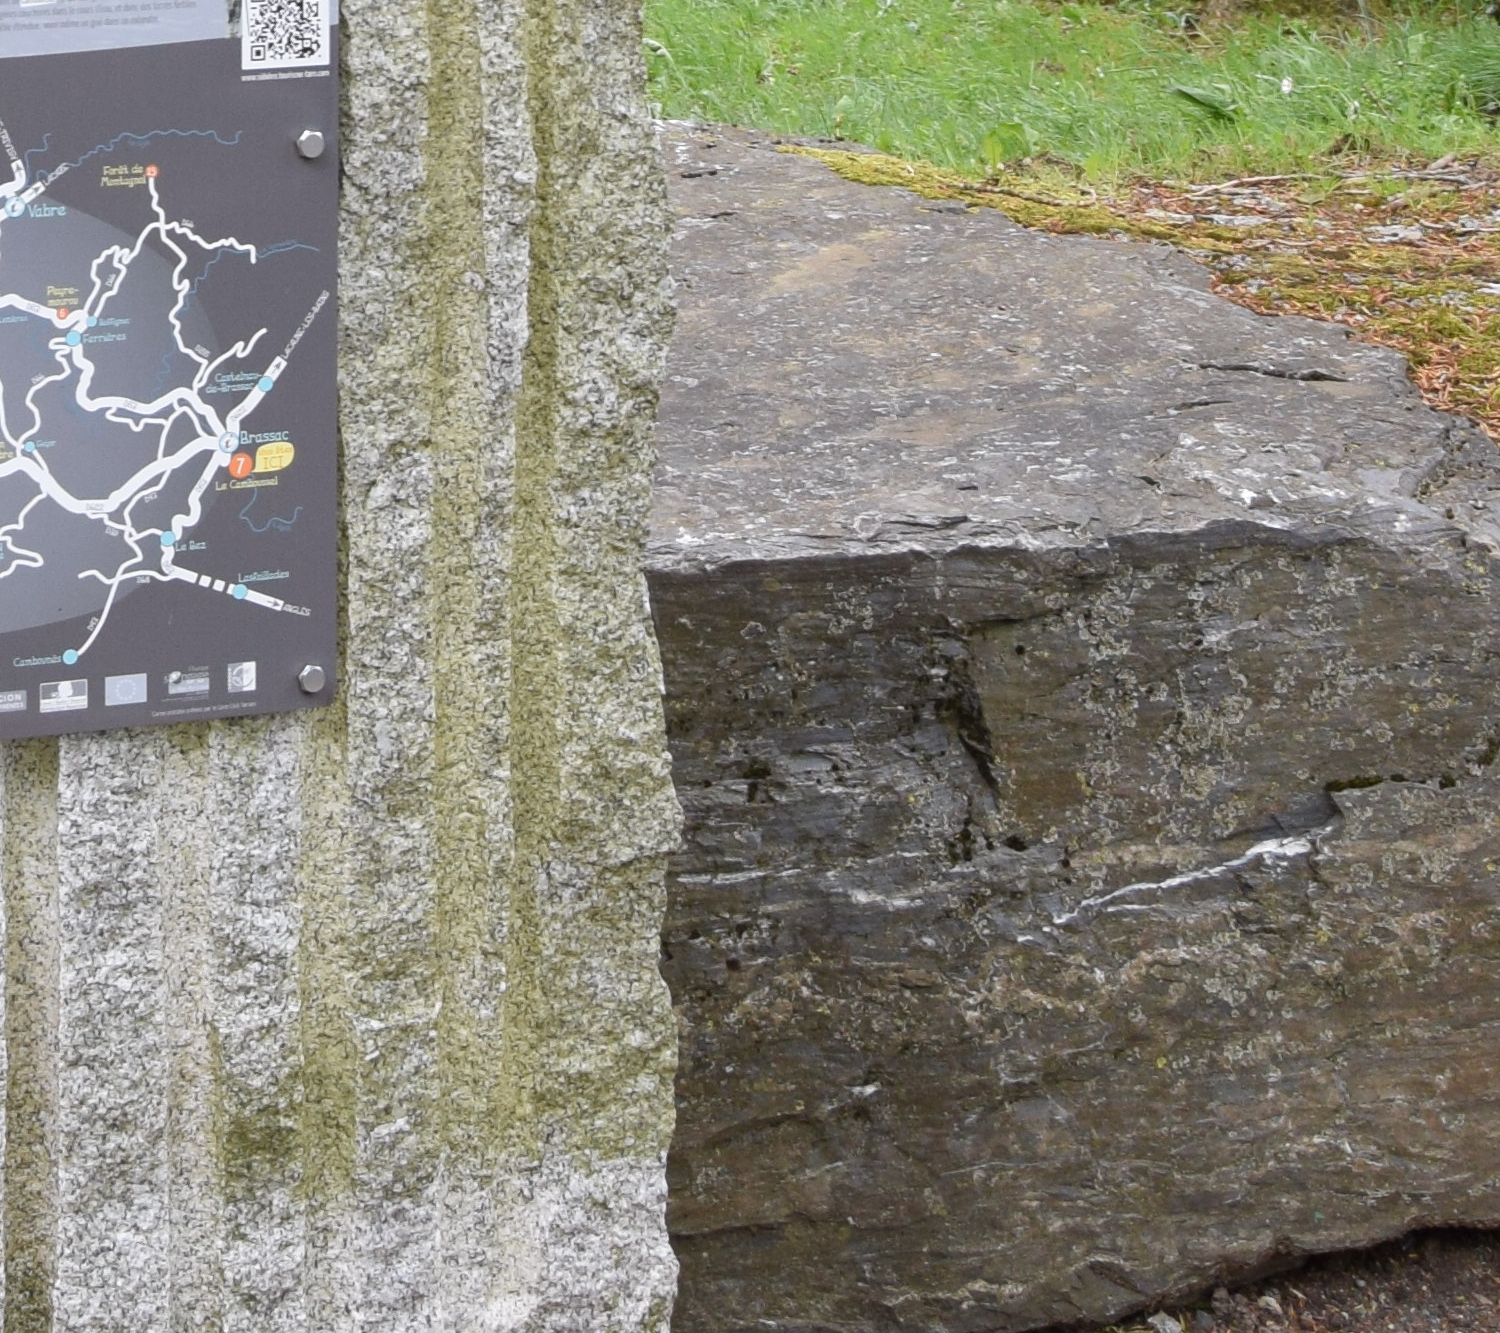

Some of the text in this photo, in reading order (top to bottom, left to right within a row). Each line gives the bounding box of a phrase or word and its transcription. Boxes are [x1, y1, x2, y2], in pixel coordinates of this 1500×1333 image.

[131, 164, 144, 174] de
[28, 203, 67, 218] Vabre
[239, 430, 290, 445] Brassac
[235, 457, 245, 475] 7
[263, 456, 285, 470] ICI
[215, 480, 228, 491] Le
